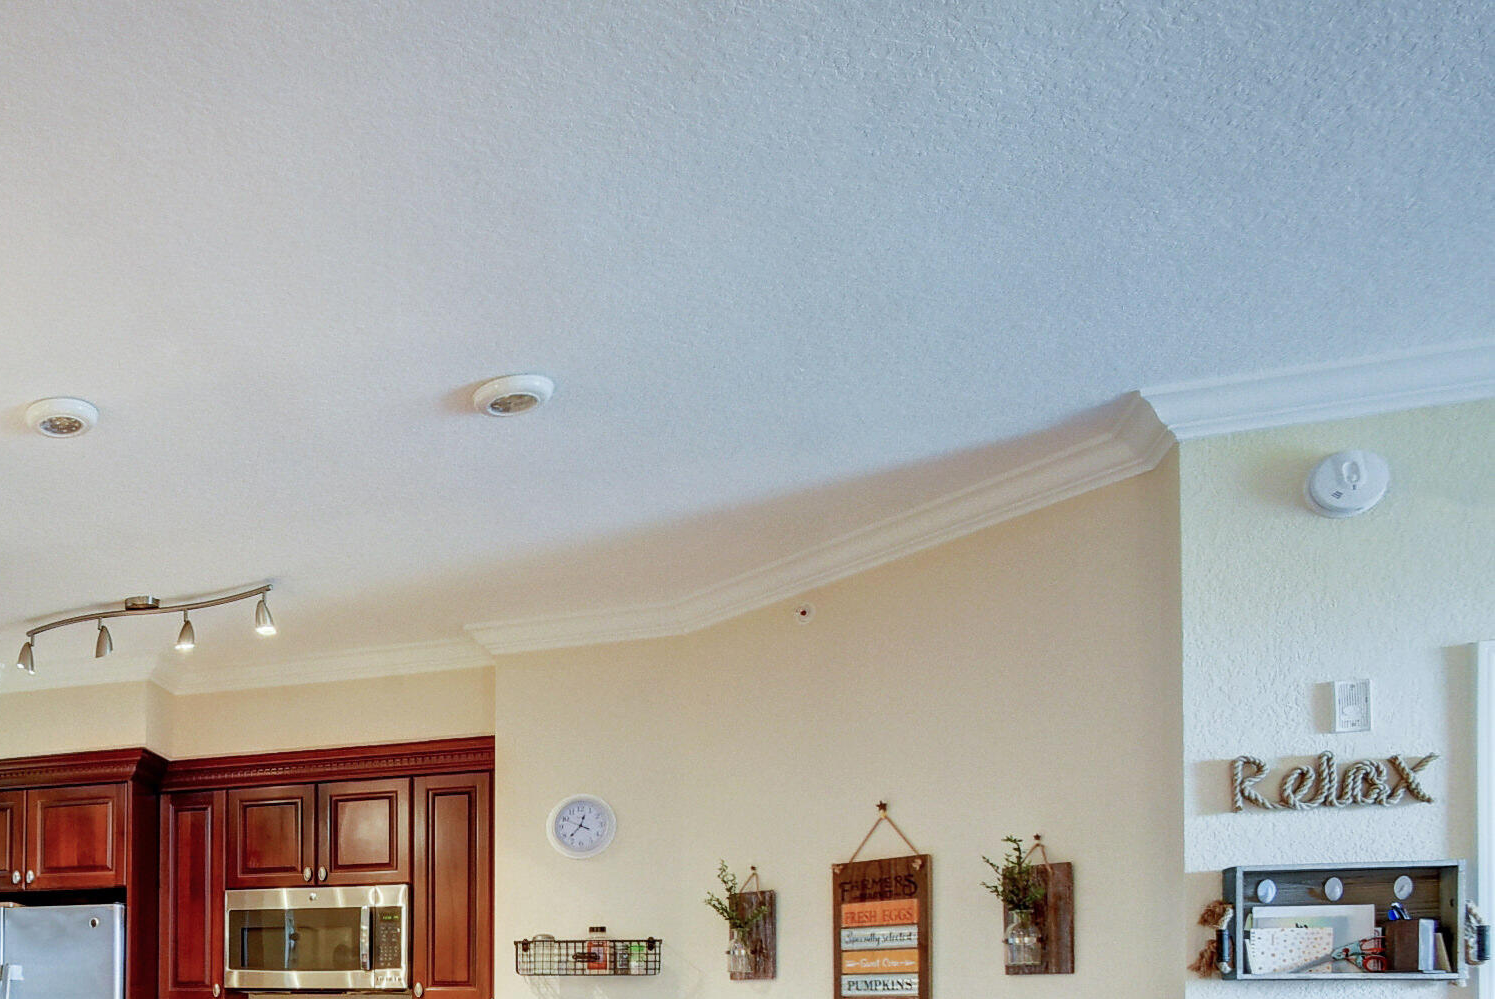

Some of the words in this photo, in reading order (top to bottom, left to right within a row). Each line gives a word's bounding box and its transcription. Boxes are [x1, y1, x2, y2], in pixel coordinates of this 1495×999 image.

[1231, 750, 1439, 813] Relax
[845, 909, 877, 924] FRESH
[882, 907, 913, 922] EGGS
[847, 979, 913, 992] PUMPKINS
